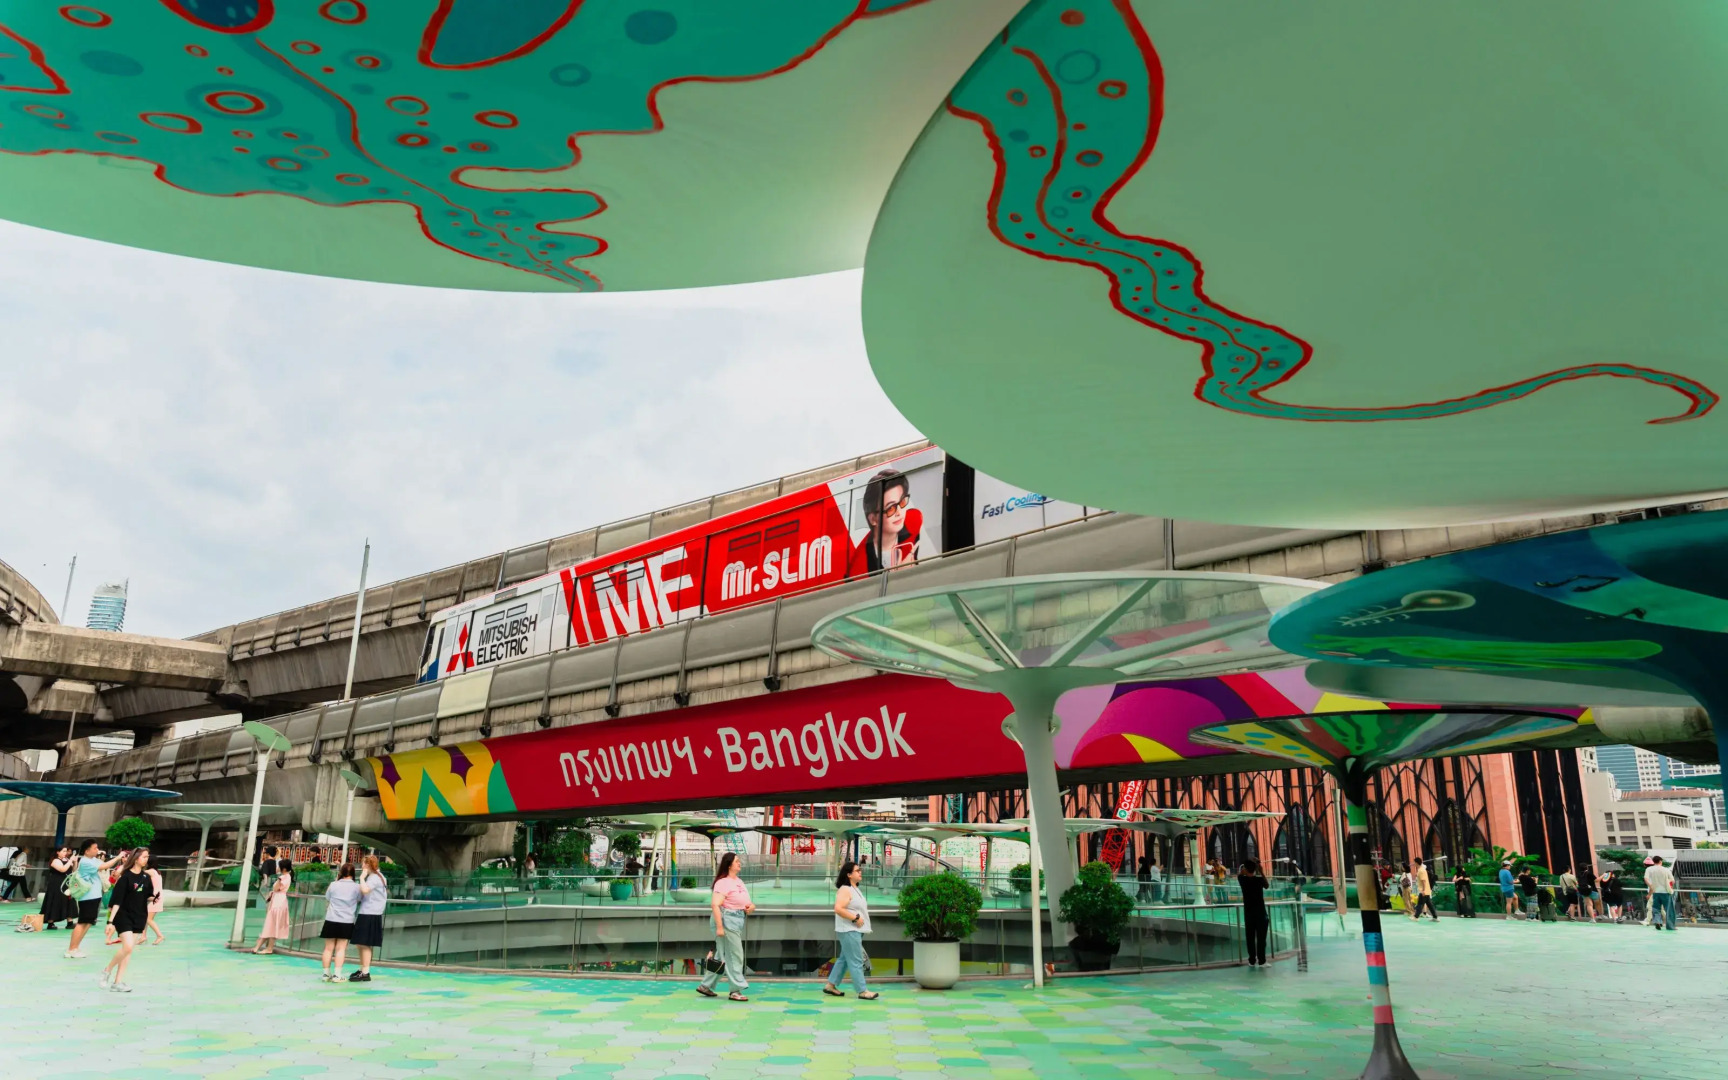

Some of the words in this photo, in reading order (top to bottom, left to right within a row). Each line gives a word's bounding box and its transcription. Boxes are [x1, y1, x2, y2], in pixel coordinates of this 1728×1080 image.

[981, 503, 1005, 519] Fast
[476, 635, 529, 666] ELECTRIC
[559, 736, 698, 798] กรุงเทพฯ
[717, 704, 917, 778] Bangkok
